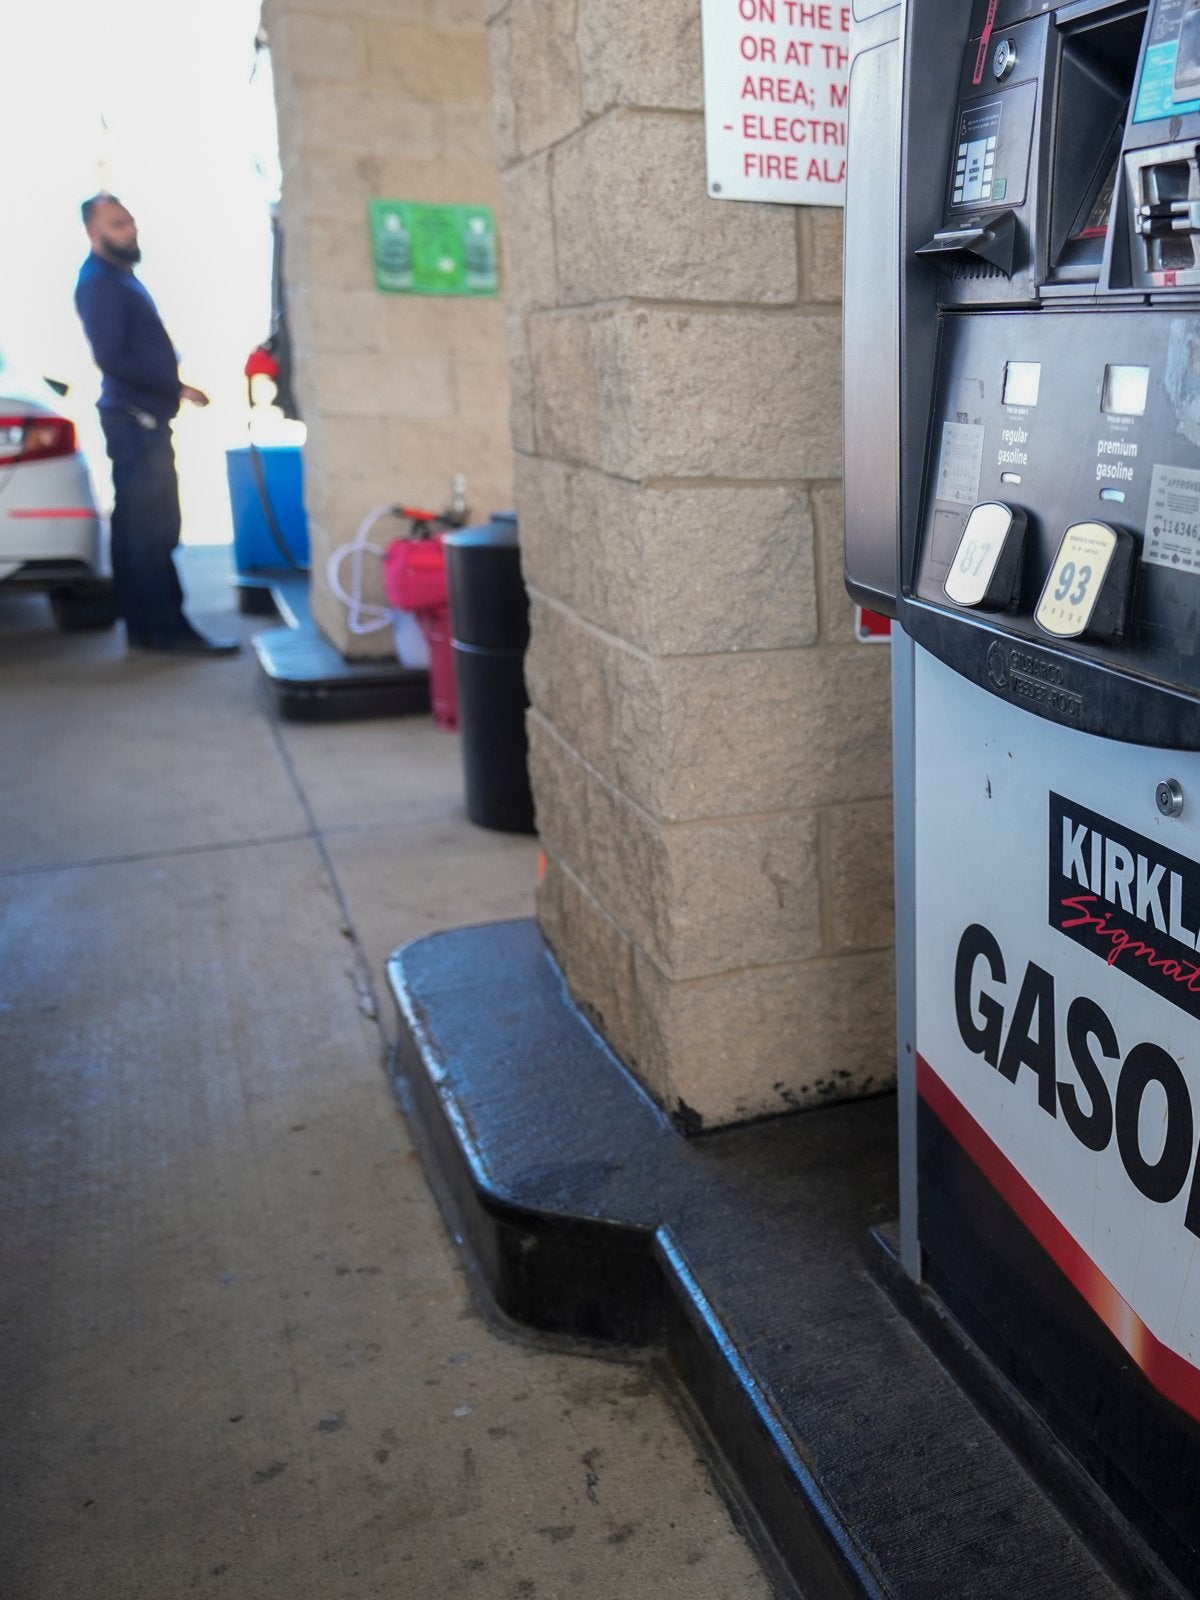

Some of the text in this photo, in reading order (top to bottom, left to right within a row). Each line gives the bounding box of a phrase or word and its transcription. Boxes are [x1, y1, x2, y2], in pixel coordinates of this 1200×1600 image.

[739, 0, 775, 23] ON
[784, 1, 831, 30] THE
[740, 35, 776, 63] OR
[785, 41, 813, 66] AT
[741, 75, 815, 110] AREA;
[743, 154, 798, 180] FIRE
[1002, 427, 1028, 445] regular
[1097, 438, 1138, 458] premium
[998, 448, 1028, 465] gasoline
[1096, 461, 1134, 480] gasoline
[1162, 519, 1198, 539] 114346
[960, 539, 992, 577] 87
[1054, 561, 1092, 606] 93
